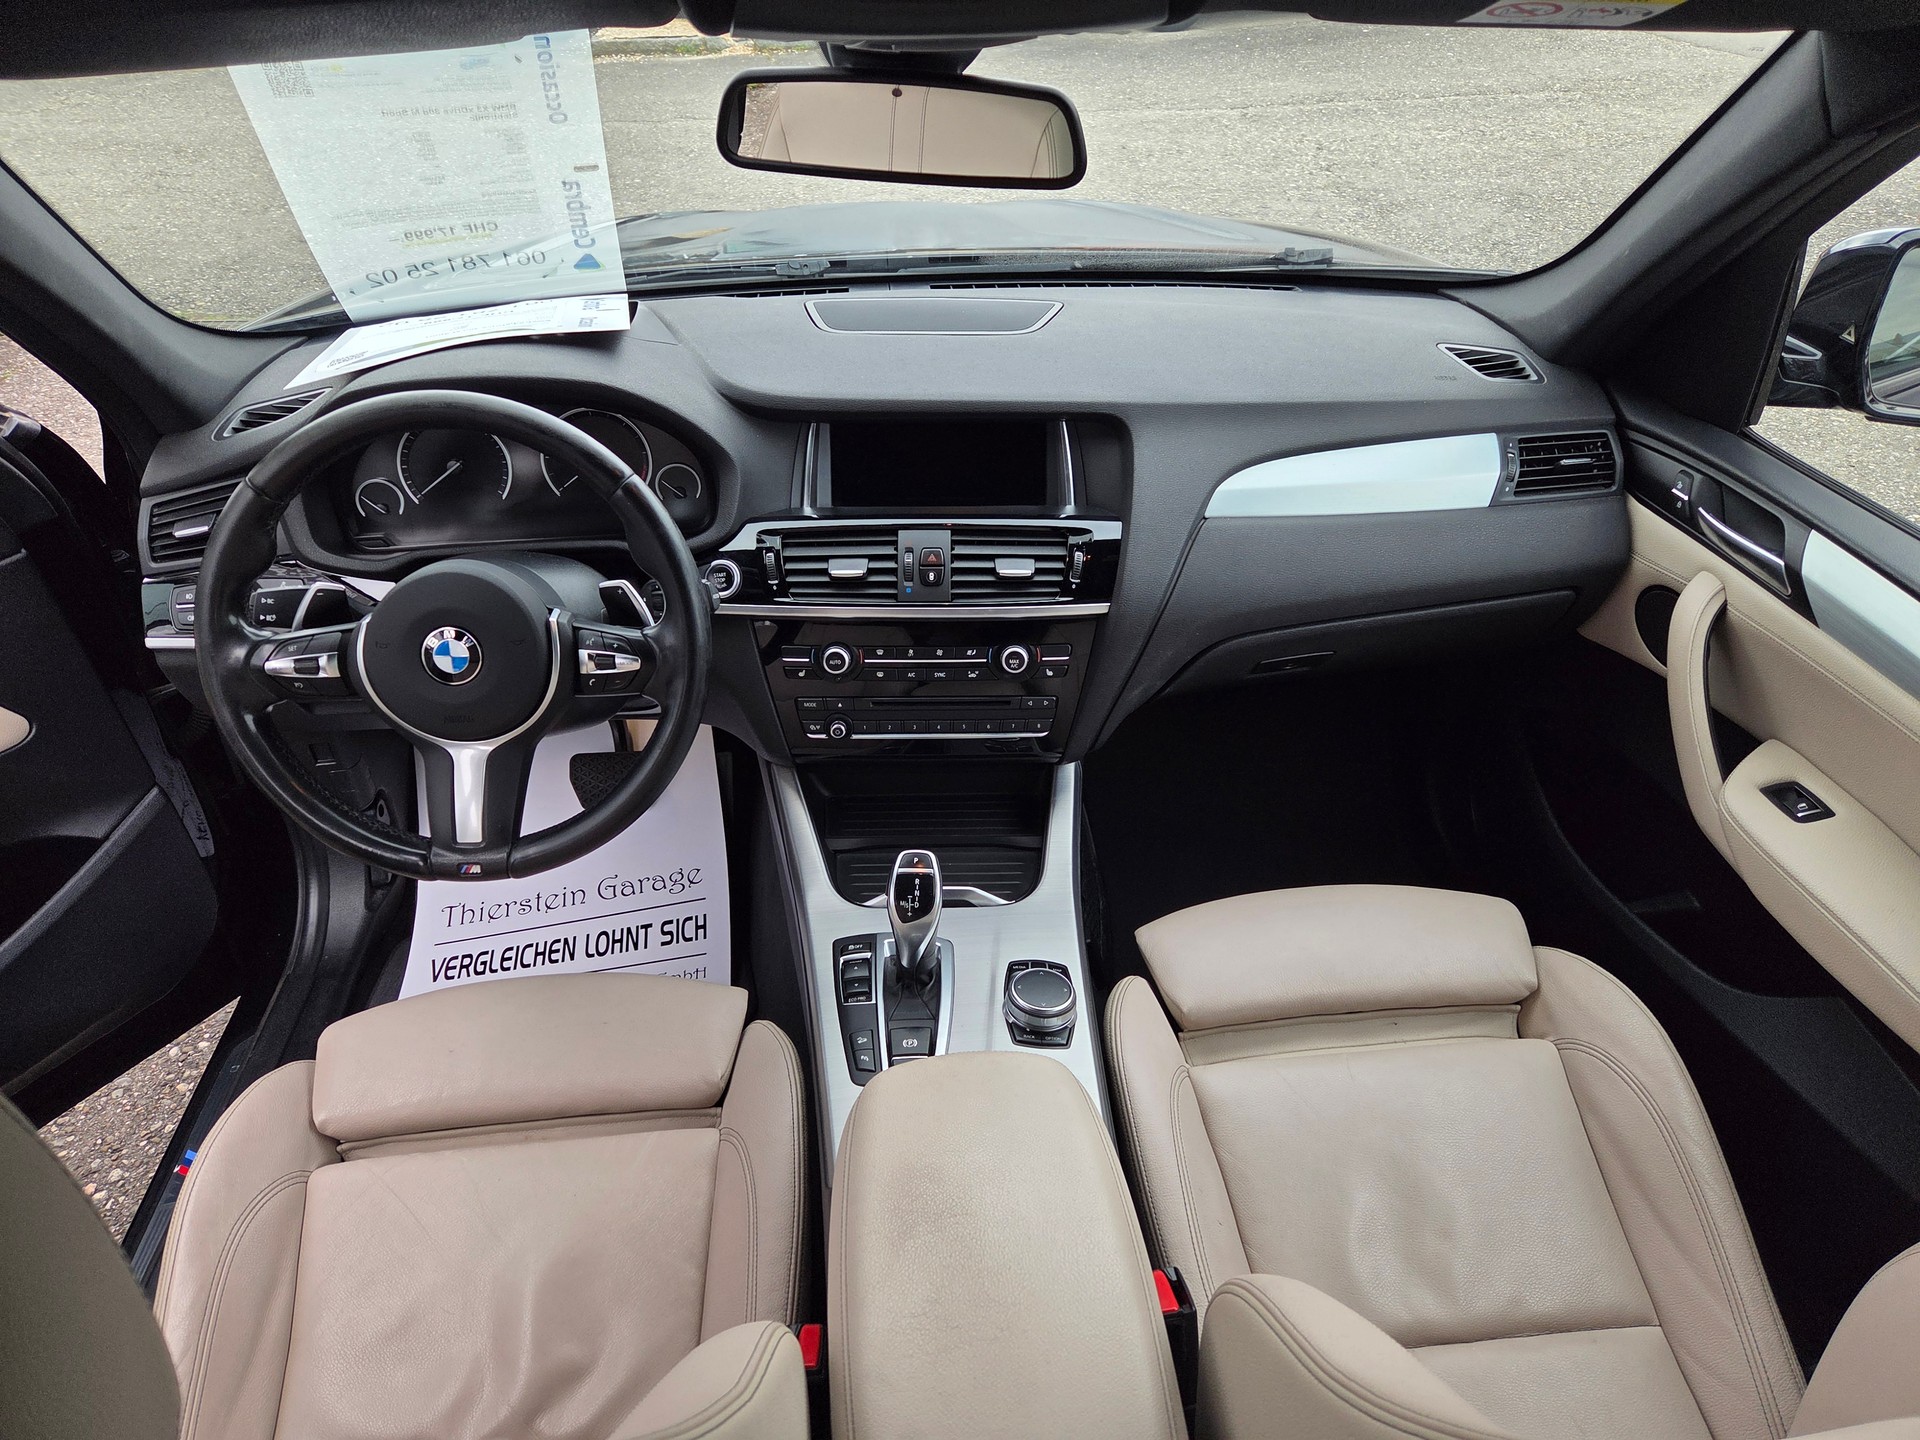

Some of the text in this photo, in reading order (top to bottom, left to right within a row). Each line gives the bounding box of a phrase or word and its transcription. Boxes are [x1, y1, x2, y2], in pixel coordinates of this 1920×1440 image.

[427, 629, 475, 648] BMW
[441, 868, 703, 928] Thierstein Garage
[431, 913, 707, 983] VERGLEICHEN LOHNT SICH
